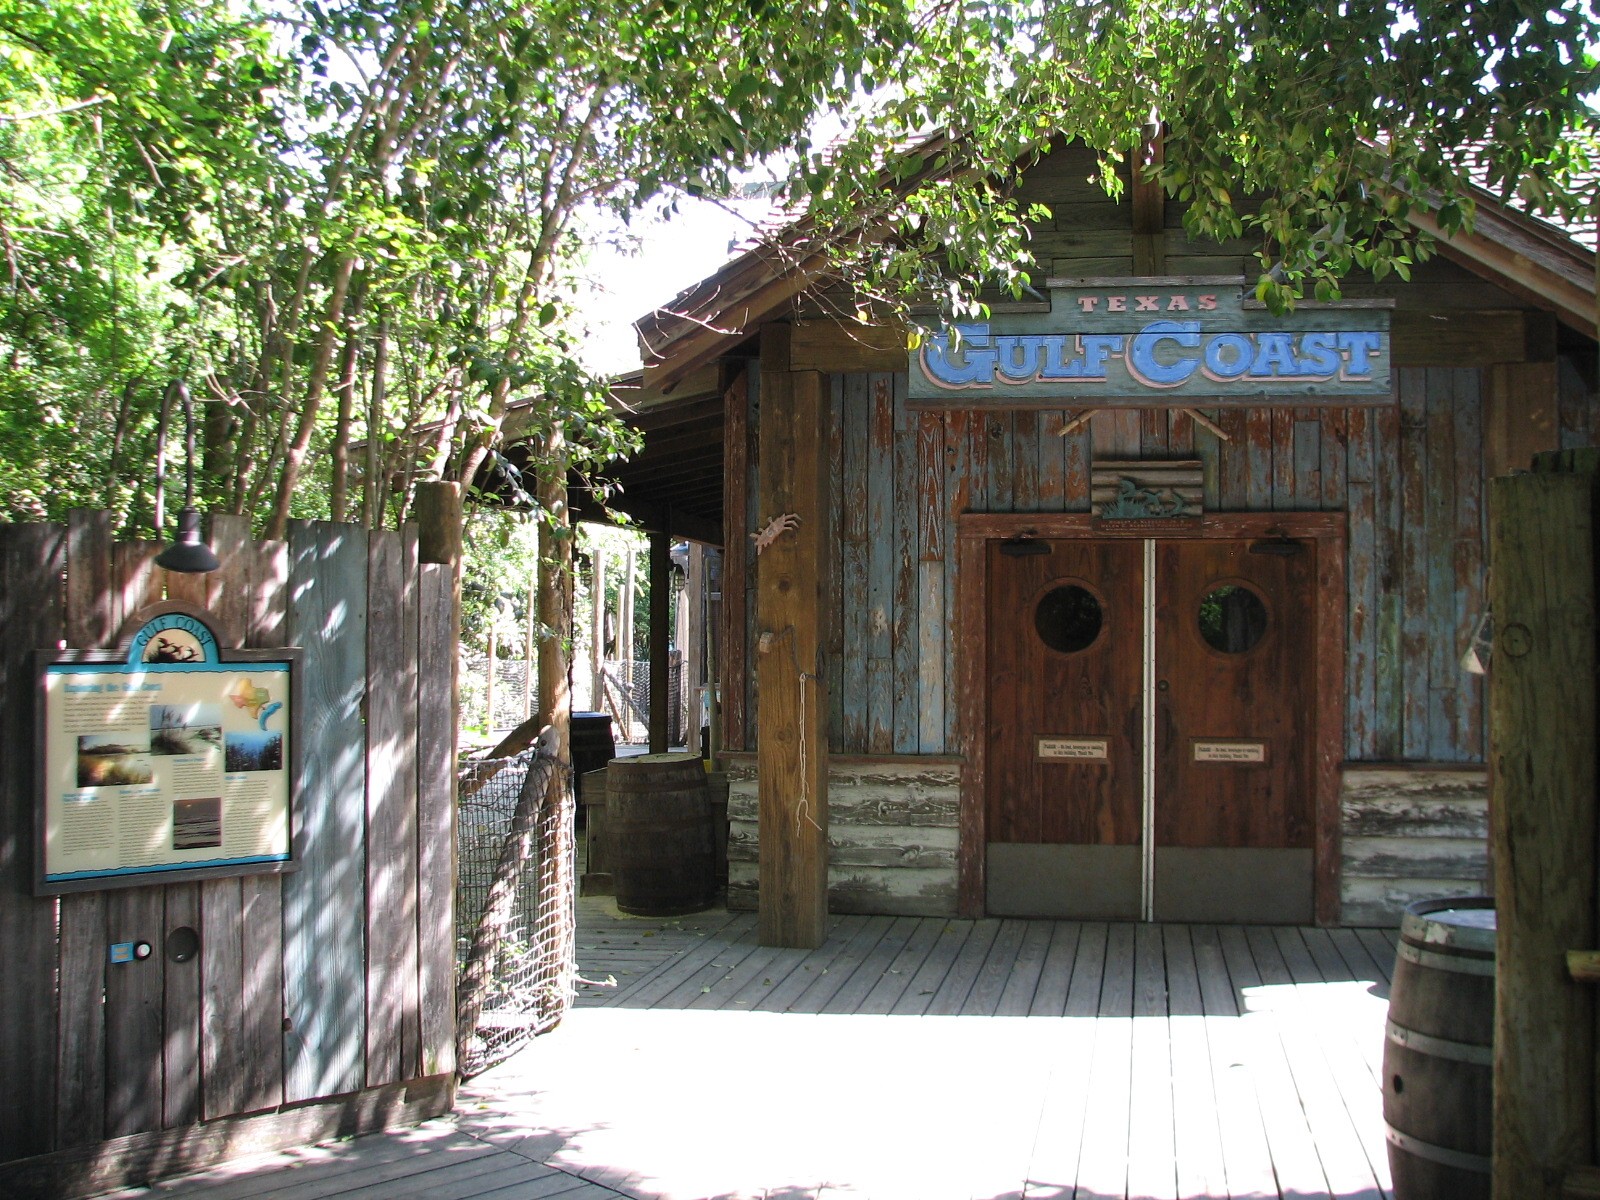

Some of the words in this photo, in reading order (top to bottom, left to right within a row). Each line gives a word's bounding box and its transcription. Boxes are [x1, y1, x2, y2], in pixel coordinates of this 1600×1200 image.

[1078, 294, 1217, 312] TEXAS
[920, 323, 1123, 388] GULF
[1126, 320, 1381, 388] COAST
[137, 617, 167, 646] GULF
[175, 616, 213, 645] COAST
